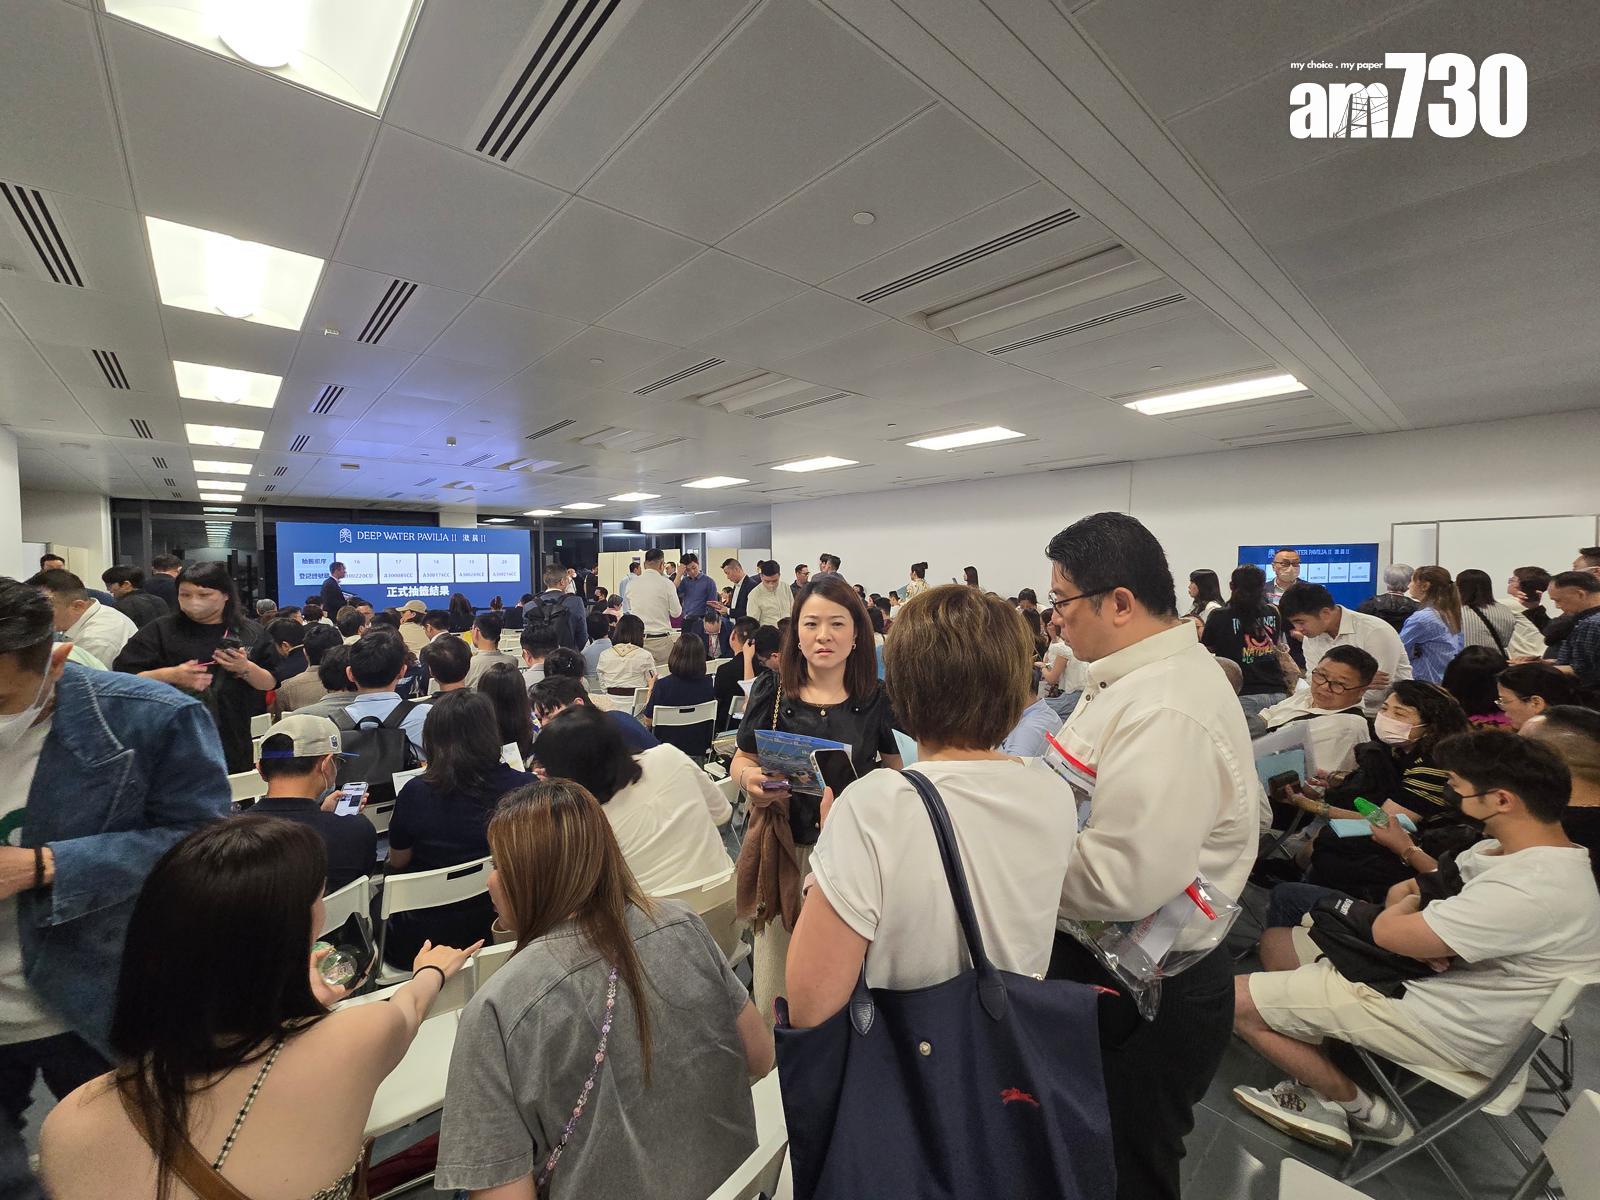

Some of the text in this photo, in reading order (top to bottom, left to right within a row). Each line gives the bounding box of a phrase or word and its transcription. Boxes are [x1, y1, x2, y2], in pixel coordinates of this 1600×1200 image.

[357, 531, 382, 540] DEEP
[383, 532, 415, 541] WATER
[417, 532, 449, 542] PAVILIA
[386, 585, 450, 598] 正式抽籤結果
